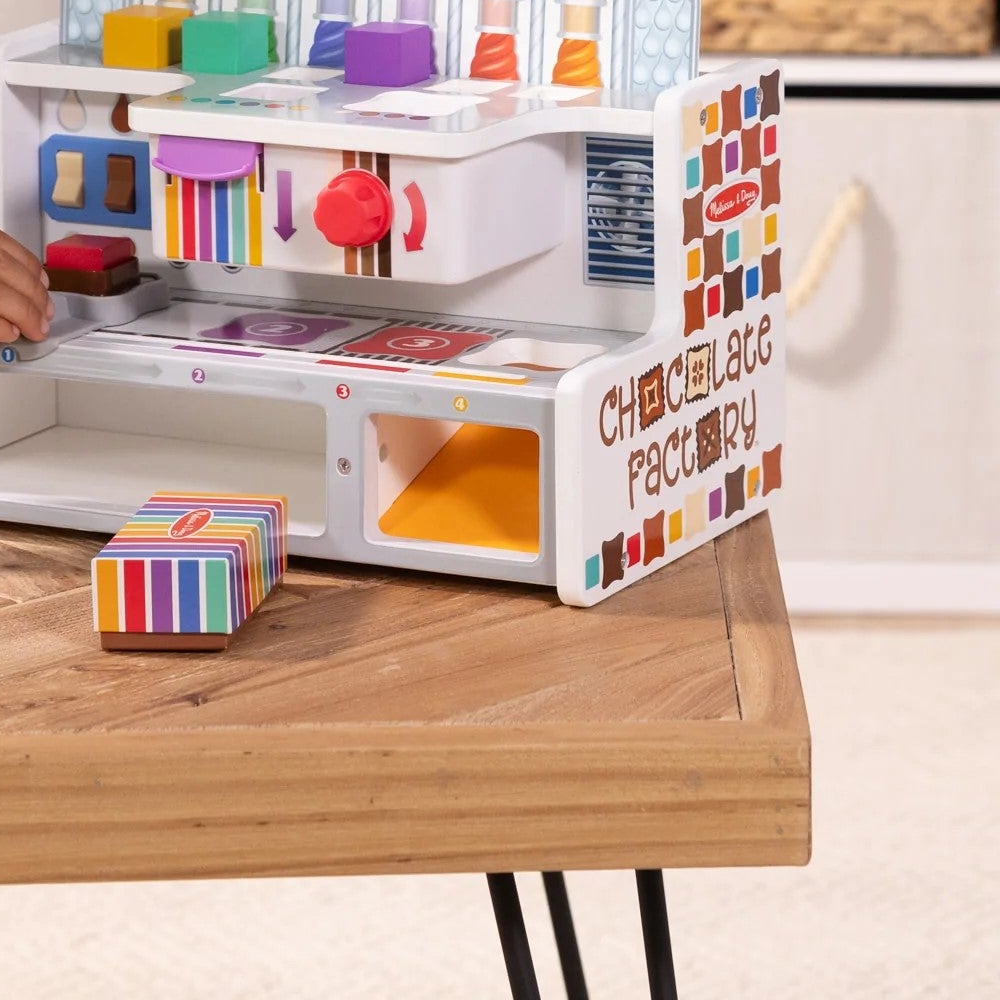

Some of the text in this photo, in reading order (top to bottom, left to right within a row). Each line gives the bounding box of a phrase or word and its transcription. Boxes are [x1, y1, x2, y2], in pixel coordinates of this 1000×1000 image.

[709, 200, 735, 218] Melissa
[260, 324, 292, 334] 2
[402, 338, 435, 348] 3
[194, 369, 203, 381] 2
[338, 385, 349, 398] 3
